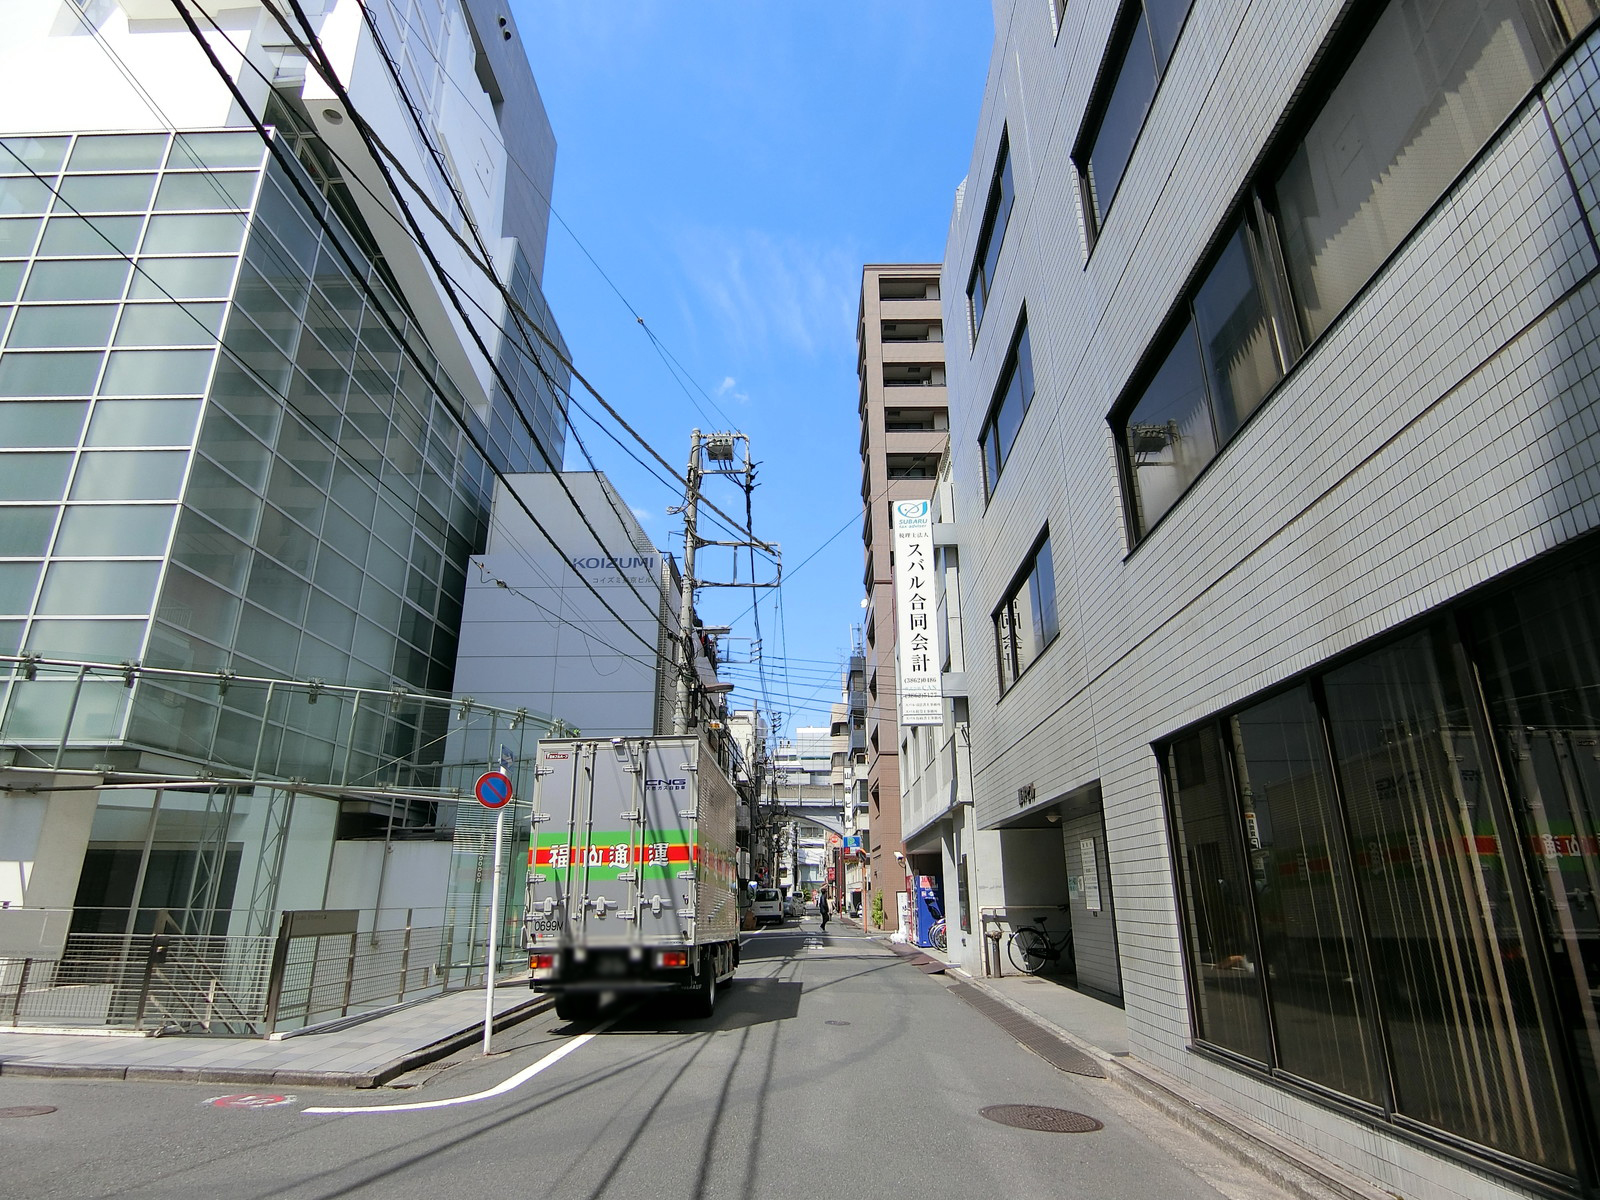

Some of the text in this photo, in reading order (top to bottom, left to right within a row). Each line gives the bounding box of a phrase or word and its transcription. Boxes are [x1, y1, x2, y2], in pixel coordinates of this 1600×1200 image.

[573, 557, 654, 569] KOIZUMI
[907, 543, 930, 673] スバル合同会計
[645, 778, 686, 786] CNG
[548, 842, 670, 869] 福山通運
